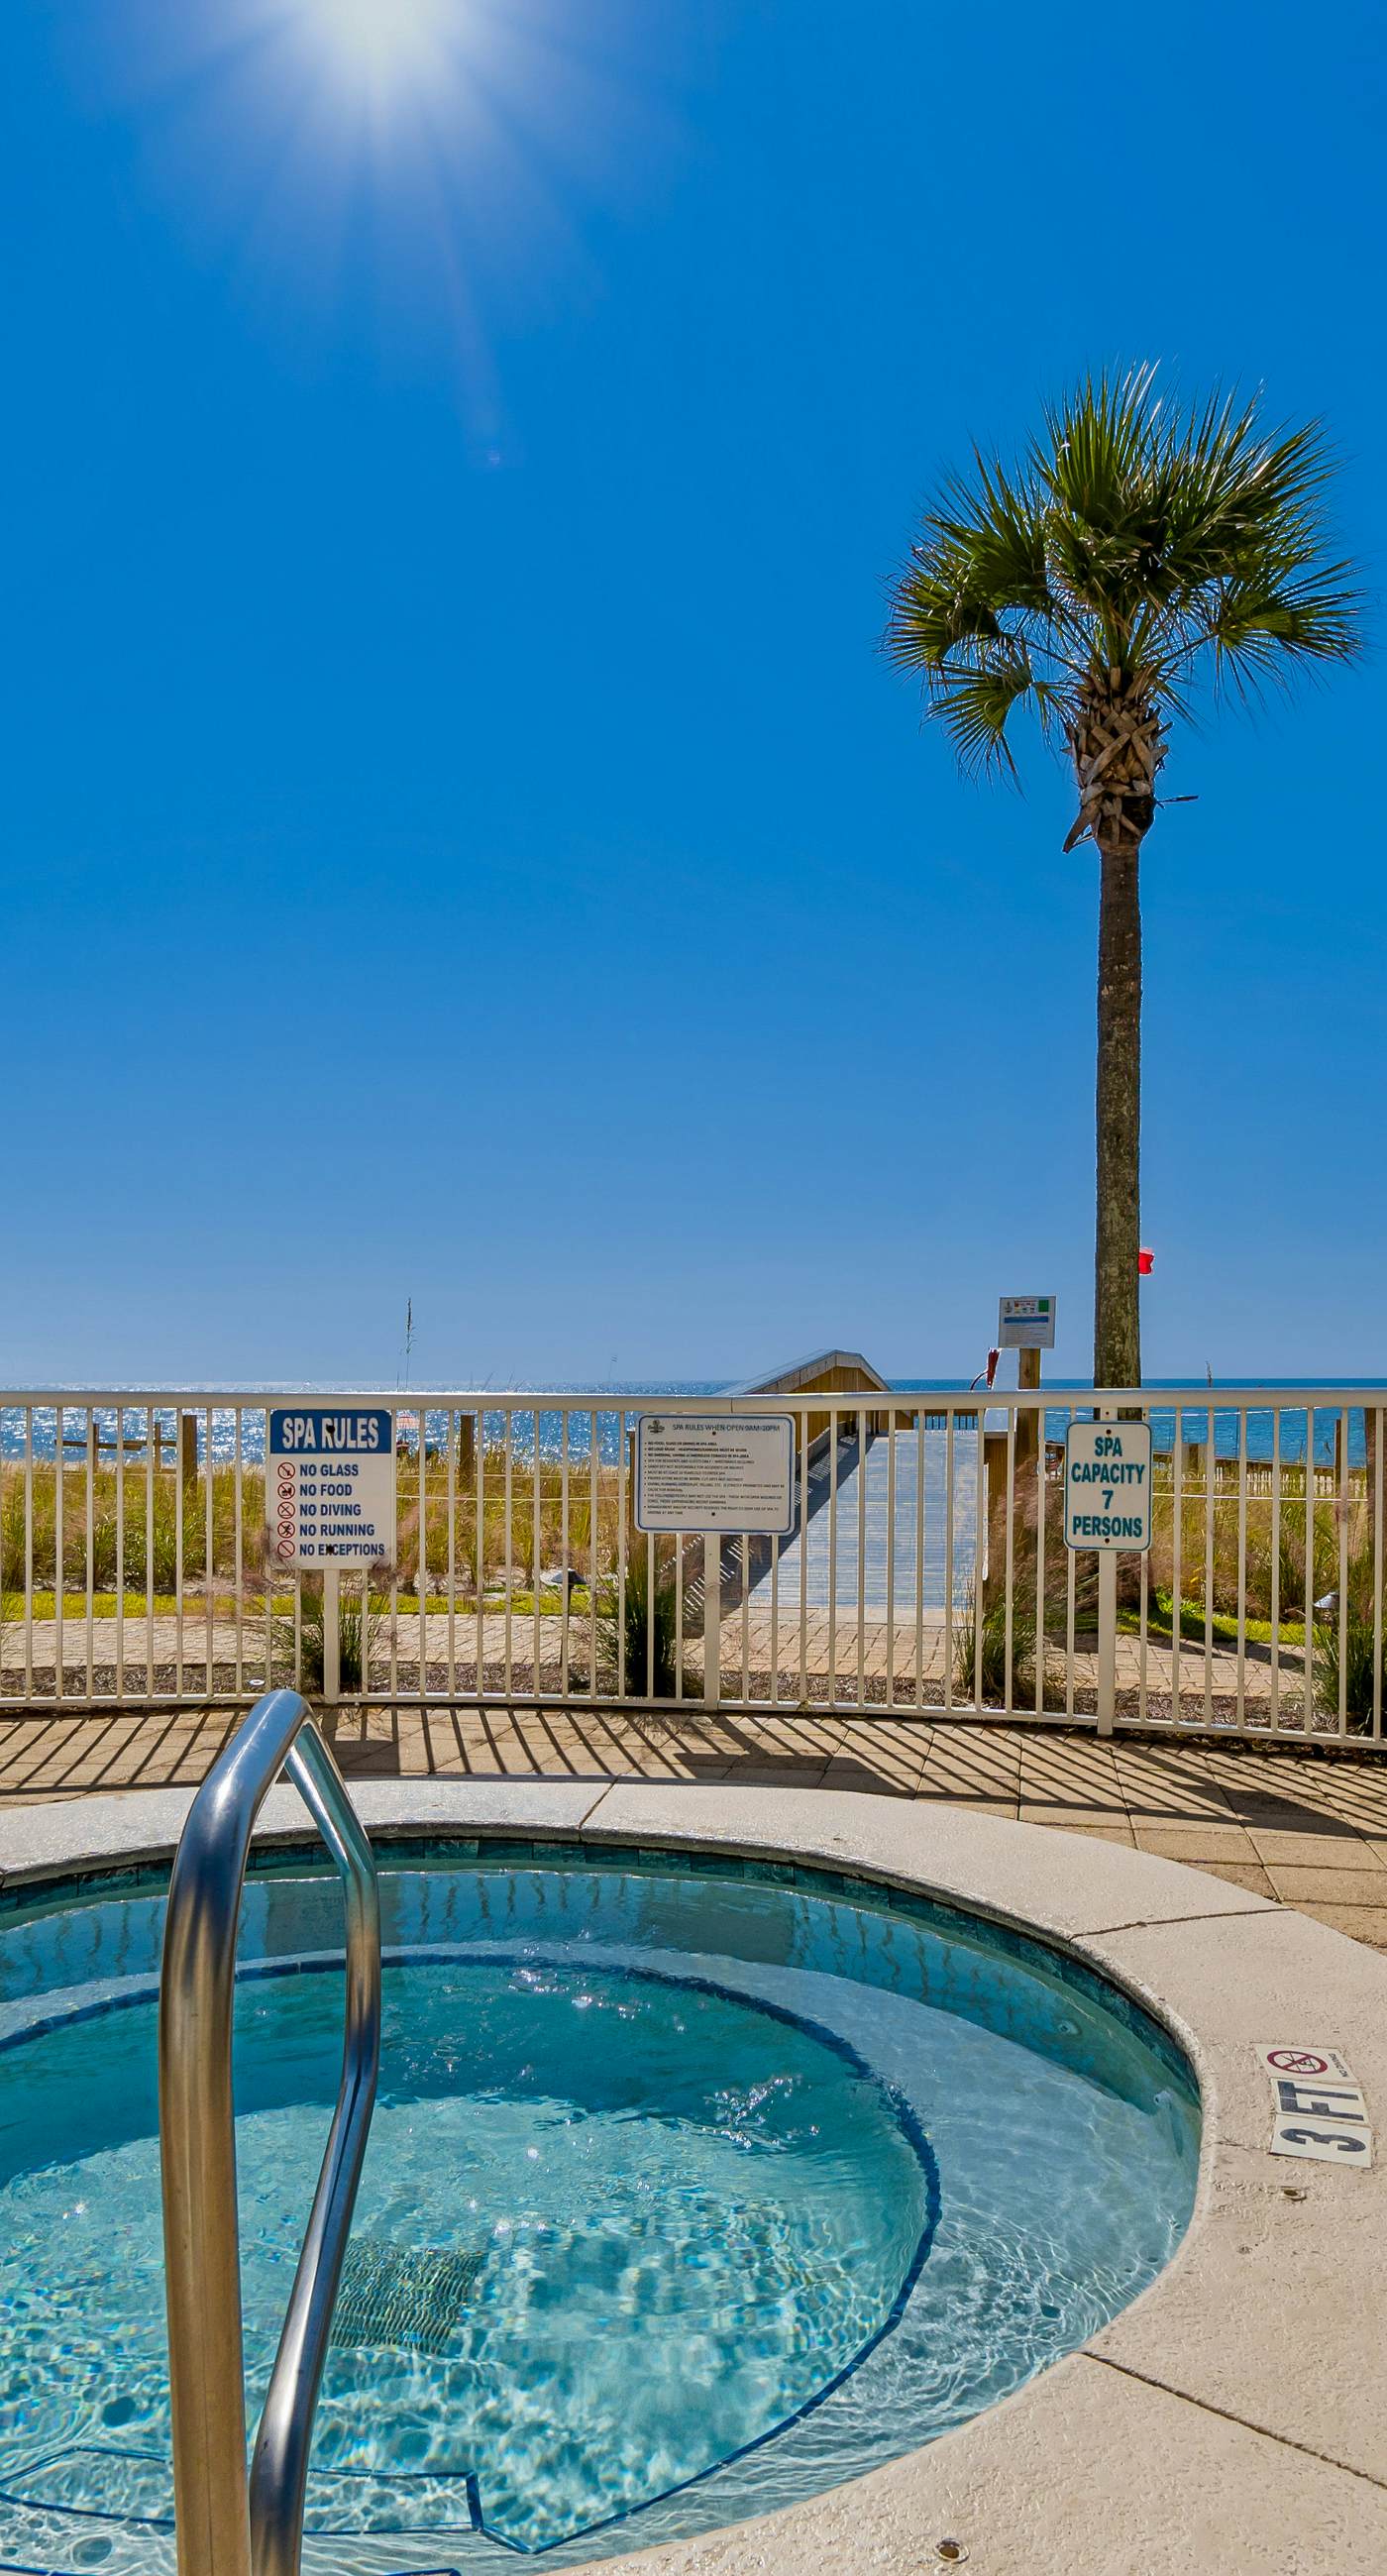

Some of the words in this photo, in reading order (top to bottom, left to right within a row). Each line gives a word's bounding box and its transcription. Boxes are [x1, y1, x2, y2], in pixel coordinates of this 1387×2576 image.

[282, 1417, 316, 1449] SPA
[321, 1417, 379, 1449] RULES
[1094, 1437, 1123, 1457] SPA
[299, 1463, 317, 1476] NO
[320, 1463, 360, 1476] GLASS
[1071, 1462, 1145, 1484] CAPACITY
[299, 1484, 317, 1496] NO
[320, 1484, 353, 1496] FOOD
[1101, 1490, 1115, 1510] 7
[299, 1503, 317, 1516] NO
[320, 1503, 362, 1516] DIVING
[299, 1524, 317, 1537] NO
[320, 1524, 375, 1537] RUNNING
[1072, 1515, 1143, 1539] PERSONS
[299, 1544, 315, 1556] NO
[1277, 2081, 1364, 2121] FT
[1280, 2127, 1366, 2152] 3
